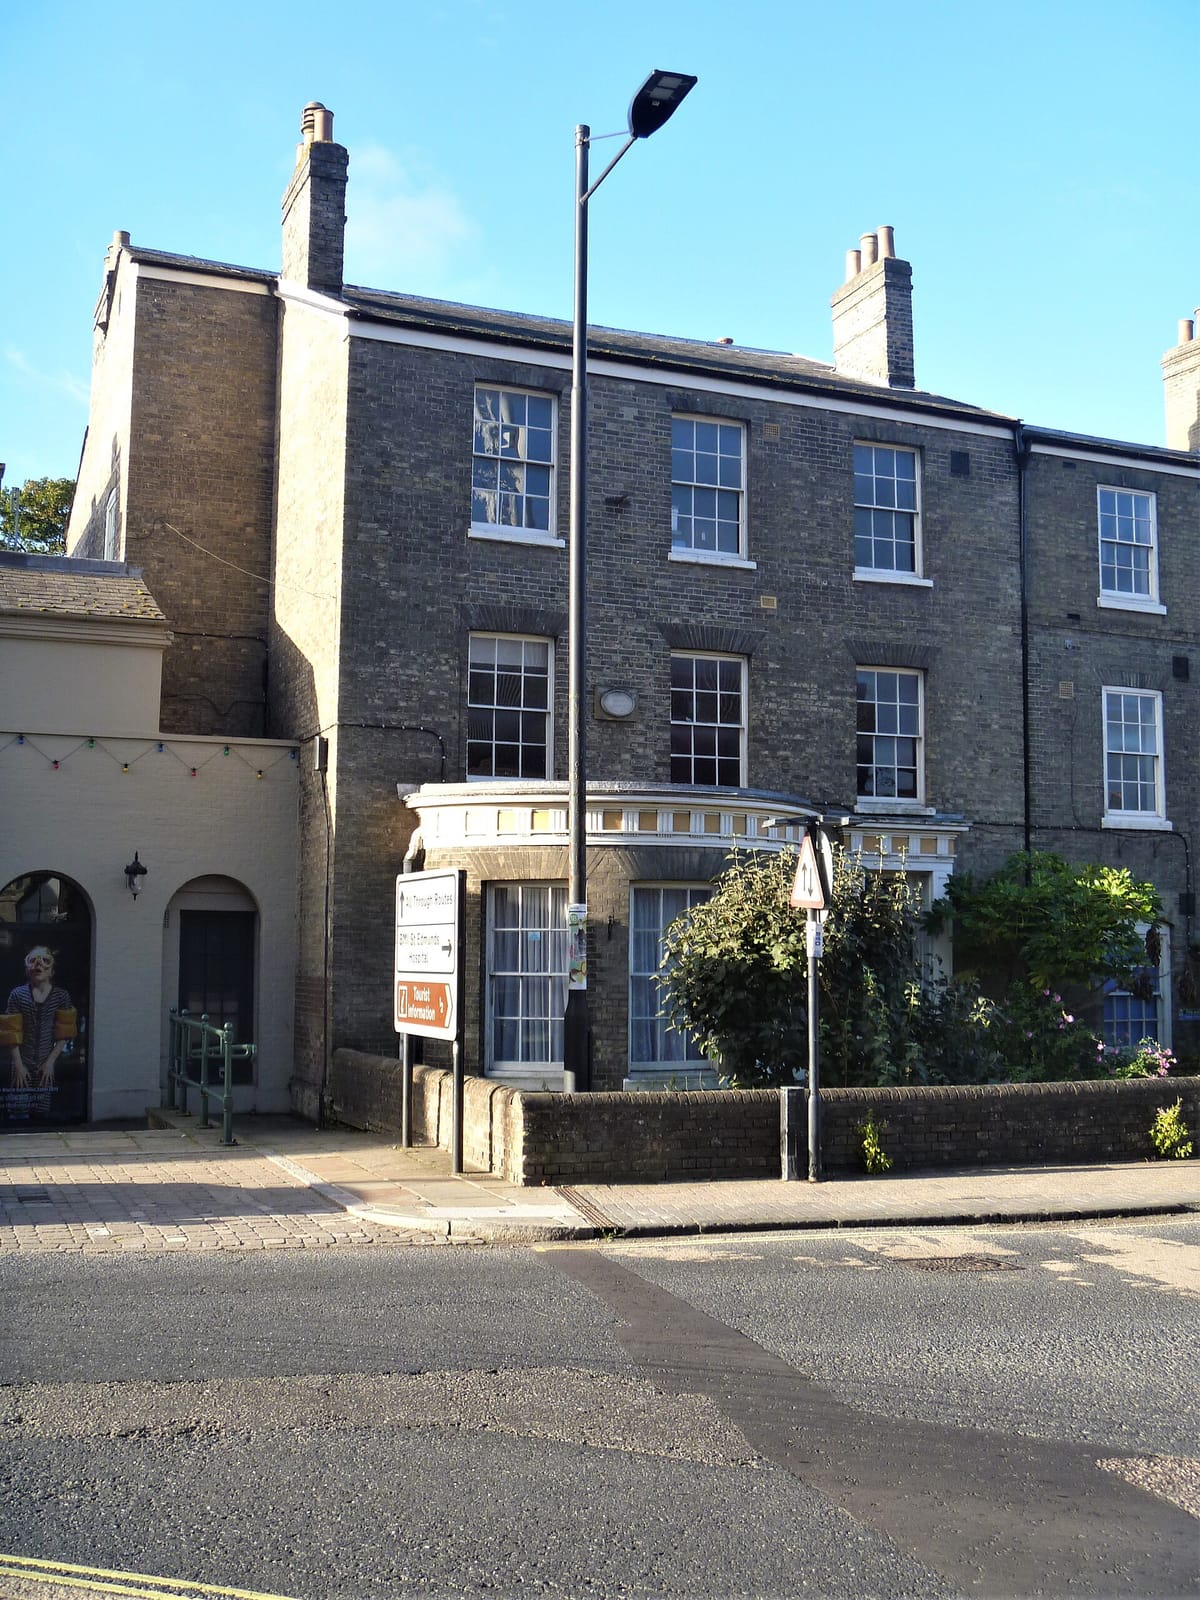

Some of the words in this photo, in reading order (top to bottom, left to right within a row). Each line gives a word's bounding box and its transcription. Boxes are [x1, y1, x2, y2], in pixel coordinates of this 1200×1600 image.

[413, 895, 433, 909] Through
[434, 892, 453, 905] Routes
[413, 986, 430, 1002] Tourist
